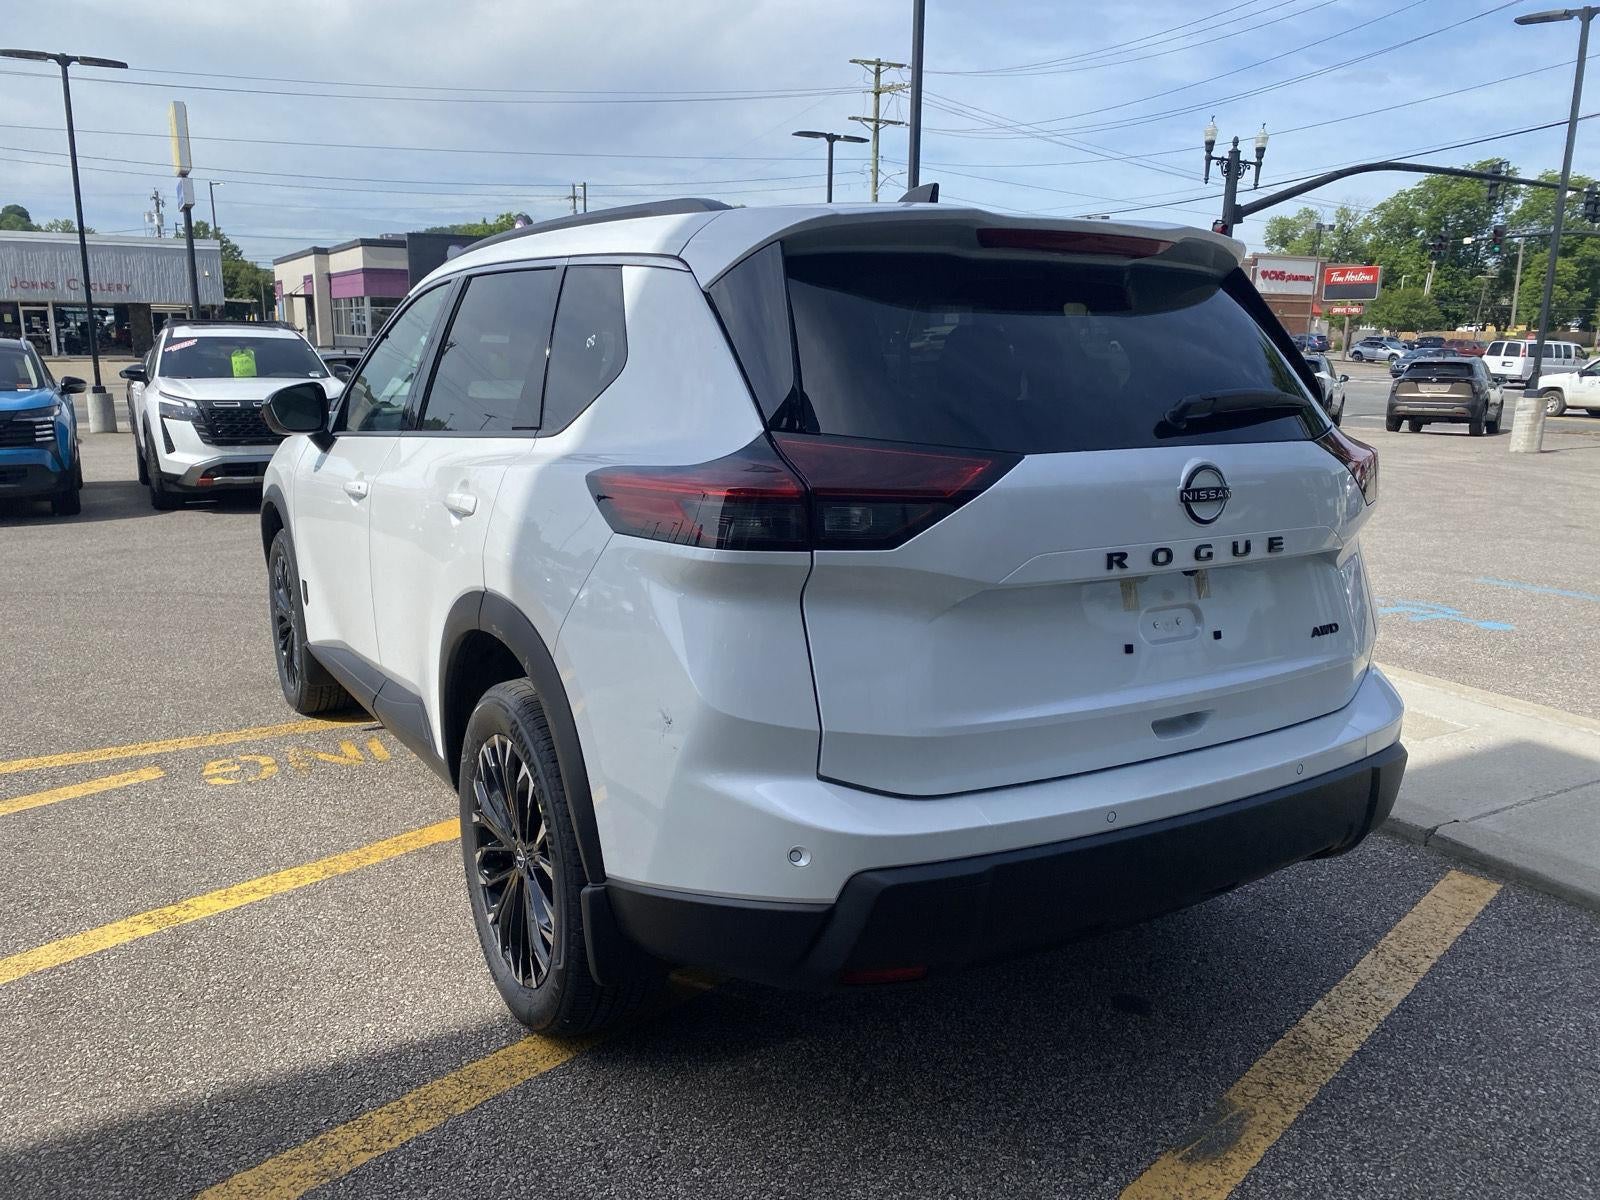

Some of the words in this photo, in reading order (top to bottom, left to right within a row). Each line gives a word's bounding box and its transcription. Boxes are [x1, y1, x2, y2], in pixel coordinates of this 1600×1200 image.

[1269, 270, 1286, 281] CVS
[1285, 272, 1315, 283] pharmac
[1330, 271, 1344, 283] Tim
[1344, 270, 1374, 282] Hortons
[1347, 306, 1361, 314] THRU
[1182, 489, 1232, 501] NISSAN
[1106, 536, 1285, 570] ROGUE
[1311, 622, 1340, 638] AWD
